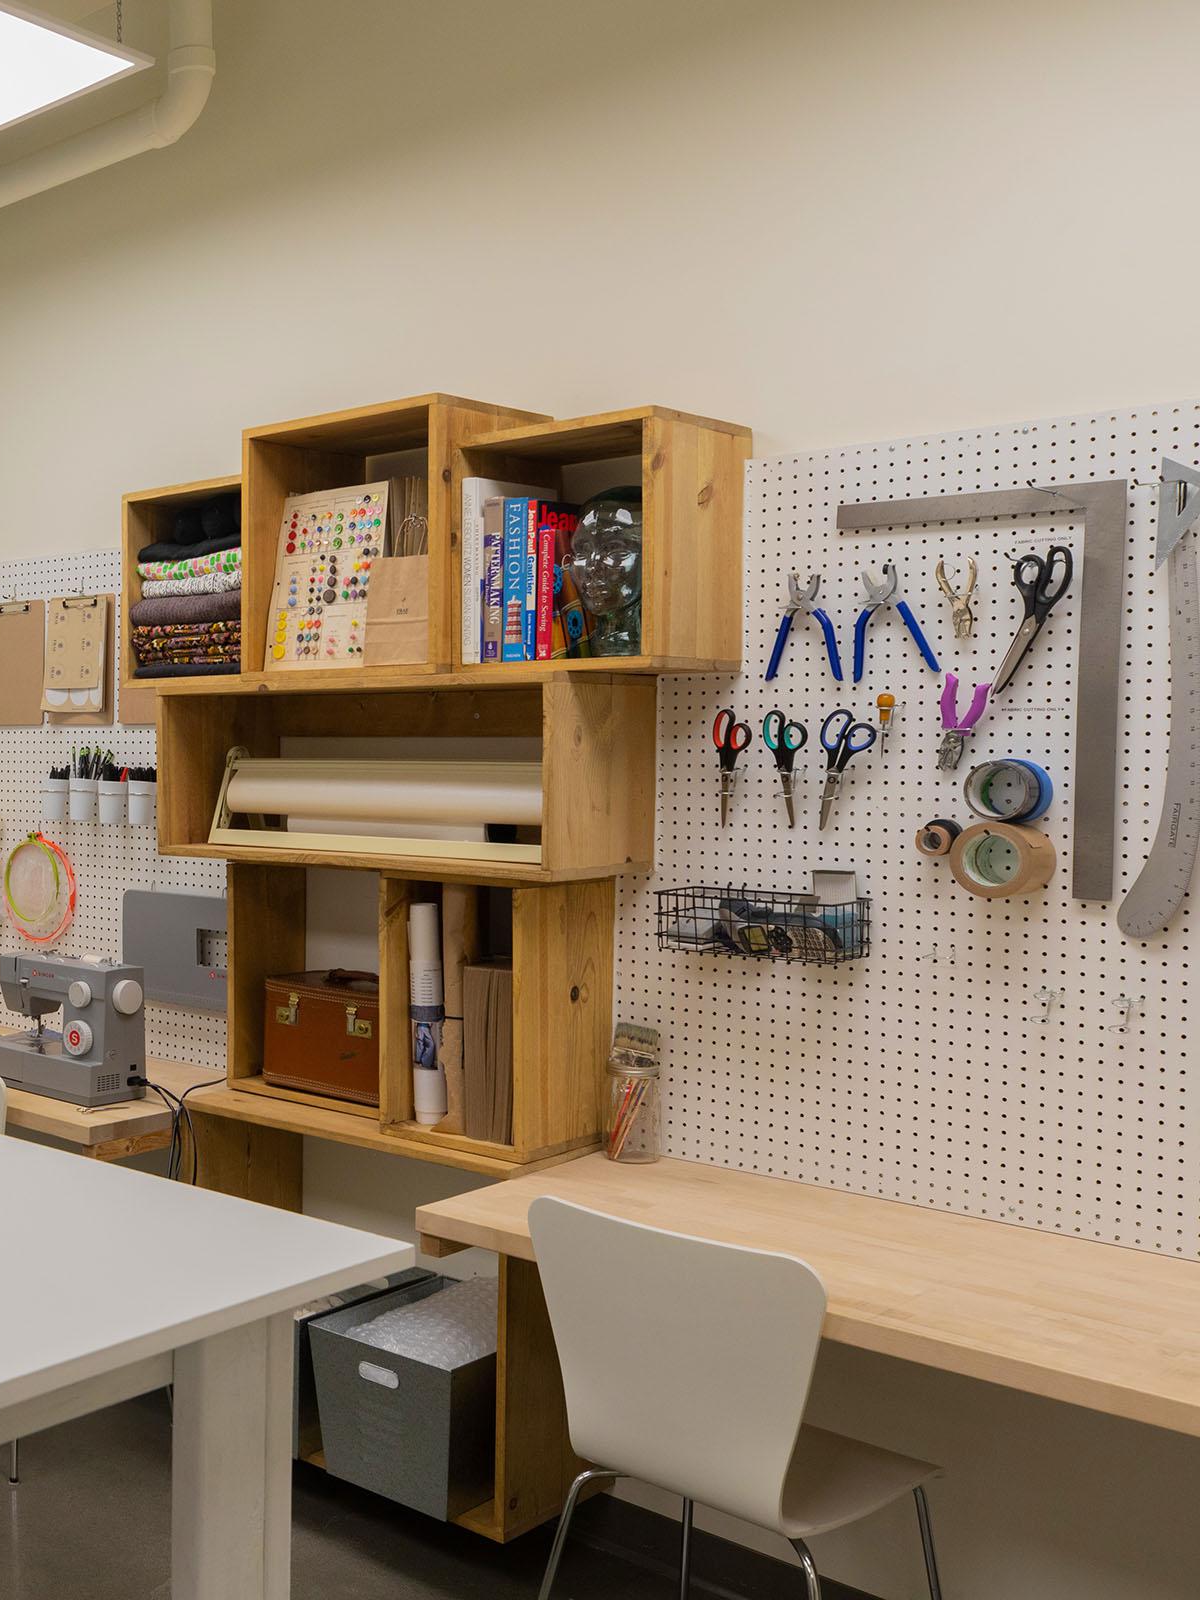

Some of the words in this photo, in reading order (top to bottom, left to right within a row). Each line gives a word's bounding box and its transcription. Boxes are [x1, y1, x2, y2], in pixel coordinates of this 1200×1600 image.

[508, 504, 521, 590] FASHION
[542, 533, 551, 569] Complete
[464, 556, 472, 587] WOMEN
[489, 532, 501, 624] PATTERNMAKING
[527, 556, 535, 595] Gaultier
[464, 588, 472, 614] SUSAN
[542, 595, 547, 603] to
[540, 605, 549, 632] Sewing
[1168, 802, 1180, 848] FAIRGATE
